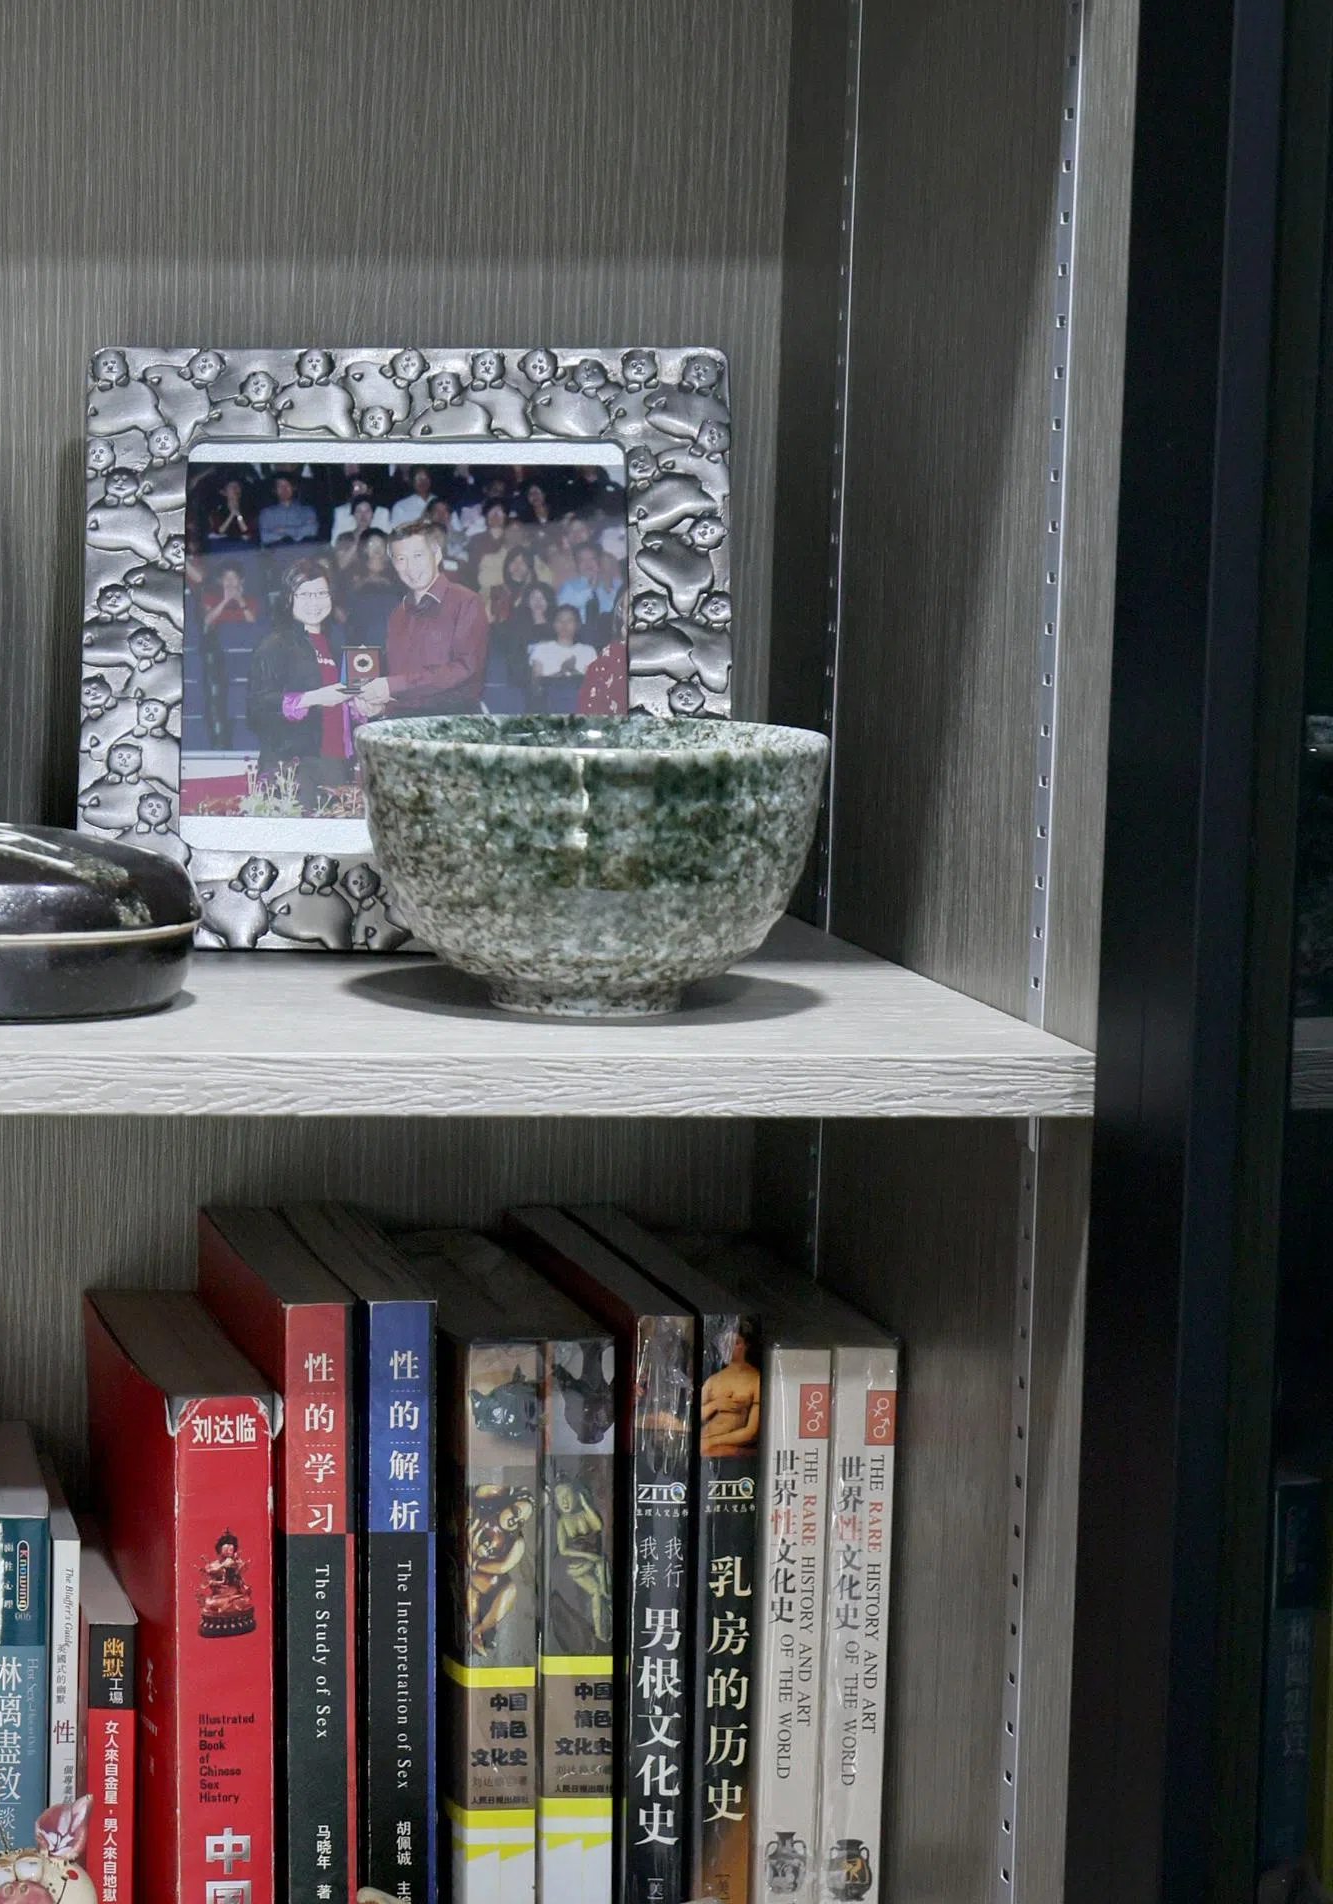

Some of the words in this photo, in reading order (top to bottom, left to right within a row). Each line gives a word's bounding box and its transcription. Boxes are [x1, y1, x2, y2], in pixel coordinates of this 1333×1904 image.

[191, 1415, 258, 1445] 刘达临
[304, 1351, 337, 1533] 性的学习
[388, 1349, 421, 1531] 性的解析
[803, 1448, 819, 1485] THE
[869, 1454, 885, 1492] THE
[769, 1450, 800, 1625] 世界性文化史
[801, 1492, 817, 1546] RARE
[868, 1499, 885, 1553] RARE
[65, 1568, 74, 1584] The
[315, 1564, 330, 1601] The
[395, 1560, 412, 1594] The
[799, 1556, 816, 1633] HISTORY
[63, 1585, 75, 1621] Bluffer's
[864, 1562, 882, 1642] HISTORY
[63, 1622, 74, 1648] Guide
[315, 1609, 331, 1666] Study
[780, 1634, 794, 1658] OF
[845, 1640, 860, 1665] OF
[103, 1637, 125, 1679] 幽默
[394, 1600, 413, 1718] Interpretation
[798, 1643, 813, 1683] AND
[863, 1650, 878, 1690] AND
[108, 1679, 124, 1705] 工場
[315, 1674, 329, 1696] of
[490, 1693, 527, 1712] 中国
[702, 1555, 750, 1823] 乳房的历史
[778, 1667, 794, 1703] THE
[843, 1673, 859, 1710] THE
[316, 1702, 331, 1739] Sex
[635, 1607, 682, 1846] 男根文化史
[796, 1690, 811, 1727] ART
[862, 1698, 877, 1734] ART
[53, 1719, 76, 1745] 性
[396, 1725, 413, 1751] of
[490, 1720, 528, 1739] 情色
[776, 1712, 793, 1780] WORLD
[840, 1719, 858, 1786] WORLD
[397, 1759, 412, 1790] Sex
[103, 1720, 120, 1903] 女人來自金星，男人來自地獄
[316, 1824, 333, 1870] 马晓年
[396, 1821, 412, 1865] 胡佩诚
[316, 1884, 332, 1900] 著
